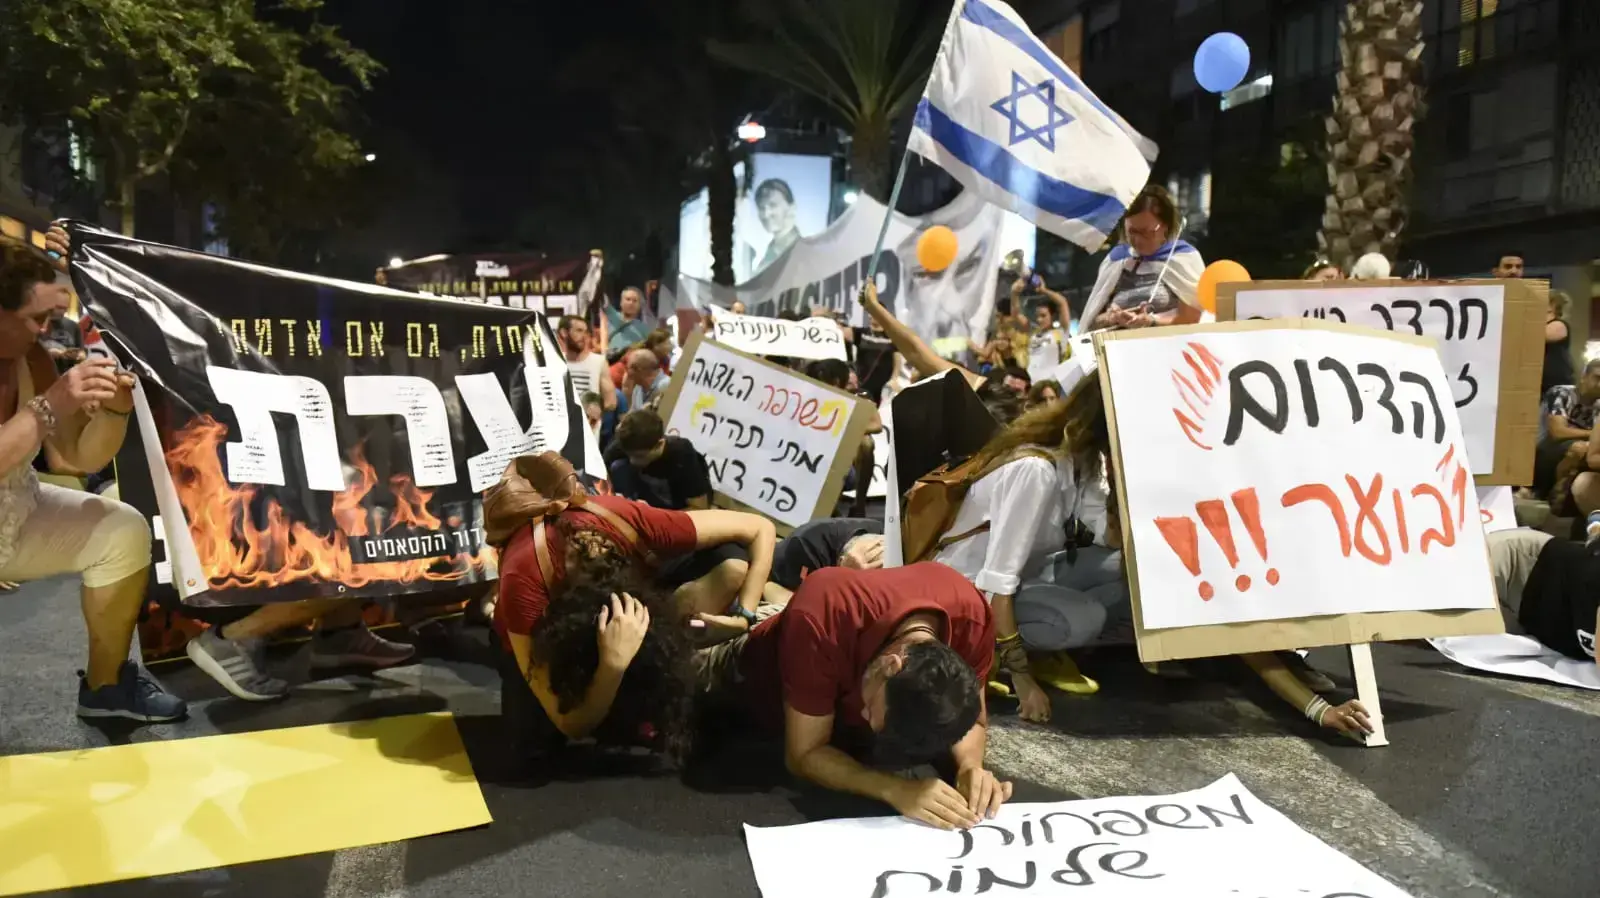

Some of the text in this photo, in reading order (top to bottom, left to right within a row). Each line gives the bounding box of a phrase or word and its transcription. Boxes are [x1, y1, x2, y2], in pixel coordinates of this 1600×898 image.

[345, 320, 385, 357] אם
[406, 322, 440, 358] גם
[795, 320, 840, 344] בשר
[690, 358, 840, 431] נשרפה האדמה
[1223, 356, 1445, 446] הדרום
[700, 411, 824, 475] מתי תהיה
[703, 453, 797, 513] פה דמ
[364, 527, 481, 558] דור הקסאמים
[946, 793, 1255, 859] משפחות
[870, 841, 1166, 898] שלמות
